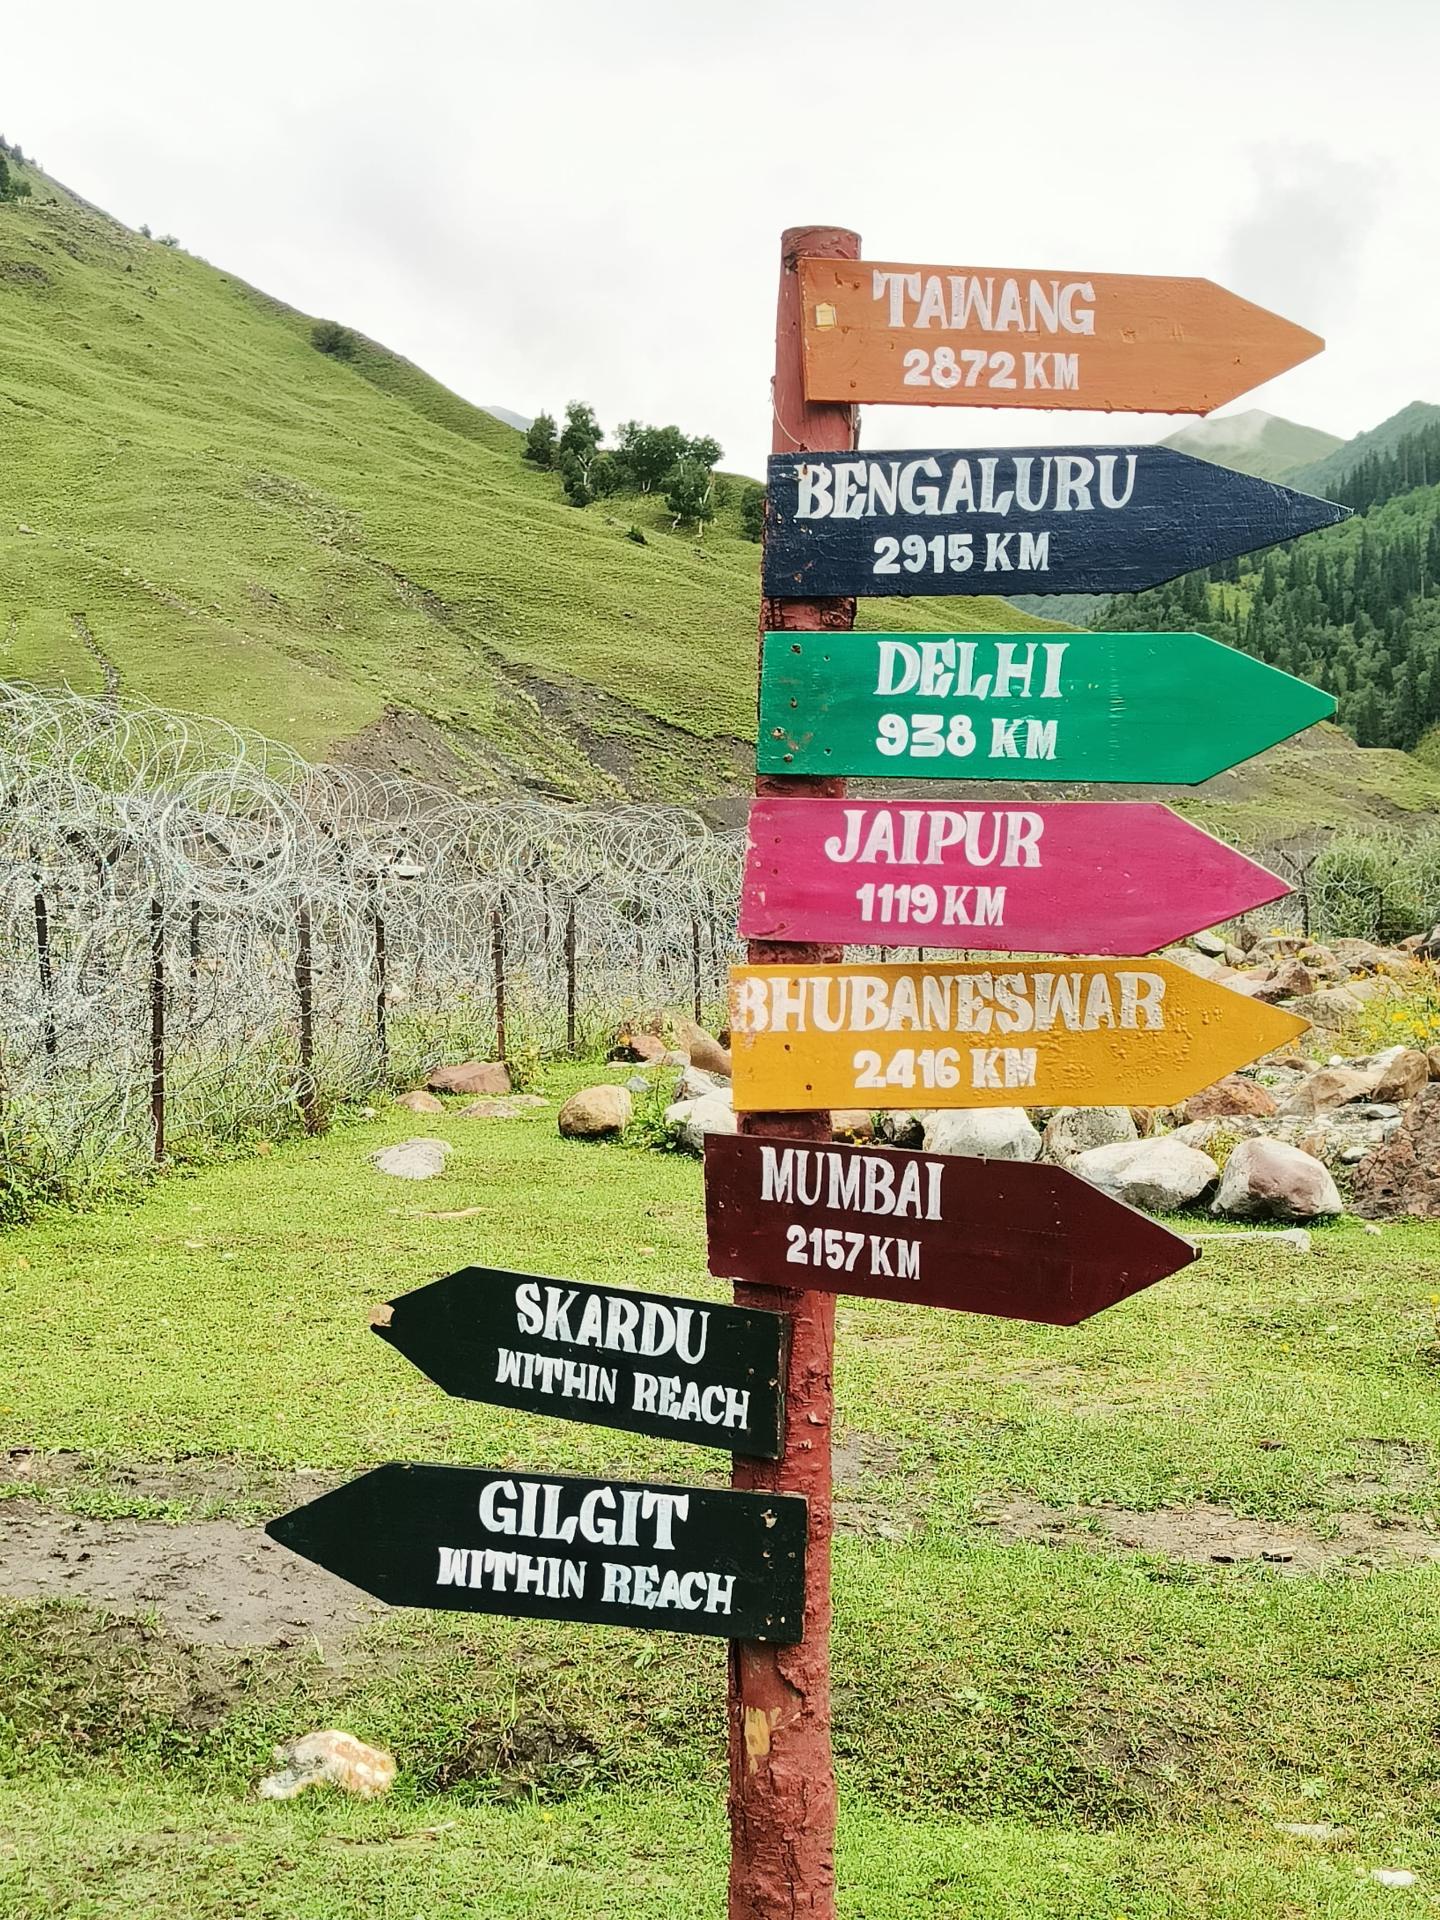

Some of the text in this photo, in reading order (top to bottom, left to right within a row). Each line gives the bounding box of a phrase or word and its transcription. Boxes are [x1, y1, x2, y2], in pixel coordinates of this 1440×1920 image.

[873, 270, 1096, 336] TAWANG
[903, 348, 1080, 391] 2872 KM
[793, 454, 1138, 520] BENGALURU
[873, 532, 1050, 574] 2915 KM
[873, 640, 1070, 699] DELHI
[876, 713, 1058, 760] 938 KM
[824, 809, 1045, 868] JAIPUR
[856, 883, 1007, 926] 1119 KM
[735, 971, 1167, 1034] BHUBANESWAR
[853, 1047, 1038, 1089] 2416 KM
[759, 1146, 946, 1221] MUMBAI
[786, 1225, 921, 1281] 2157 KM
[515, 1283, 710, 1364] SKARDU
[495, 1349, 751, 1430] WITHIN REACH
[478, 1480, 689, 1550] GILGIT
[436, 1547, 737, 1615] WITHIN REACH
